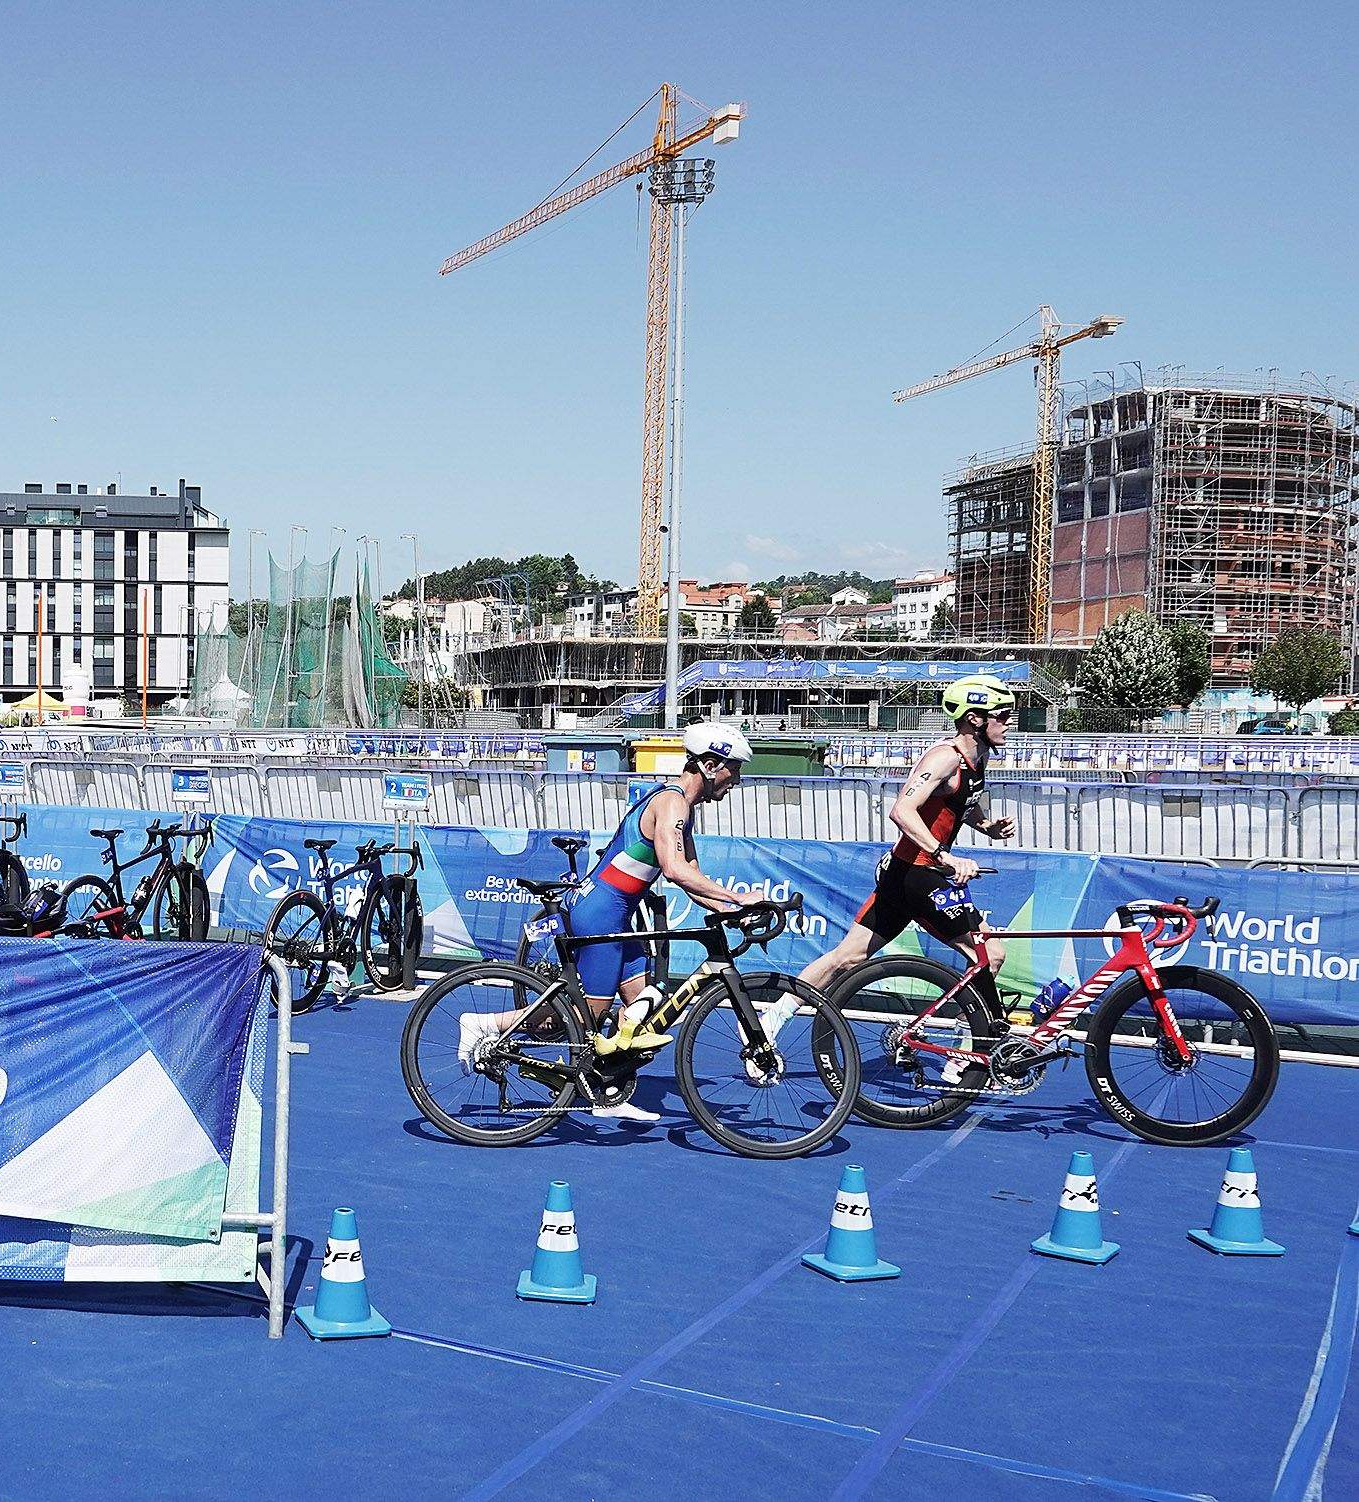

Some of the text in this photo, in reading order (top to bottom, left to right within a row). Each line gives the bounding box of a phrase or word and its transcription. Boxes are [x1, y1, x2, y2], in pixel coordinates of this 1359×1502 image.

[241, 740, 256, 749] NTT
[278, 739, 295, 749] NTT
[177, 775, 185, 787] 3
[920, 772, 932, 781] 4
[390, 782, 397, 793] 2
[634, 788, 640, 800] 1
[675, 819, 684, 830] 2
[485, 875, 505, 888] Be
[465, 888, 544, 905] extraordina
[1205, 911, 1321, 945] World
[1033, 970, 1124, 1042] CANYON
[819, 1053, 833, 1069] DT
[946, 1050, 984, 1063] CANYON
[1096, 1077, 1136, 1121] DT SWISS
